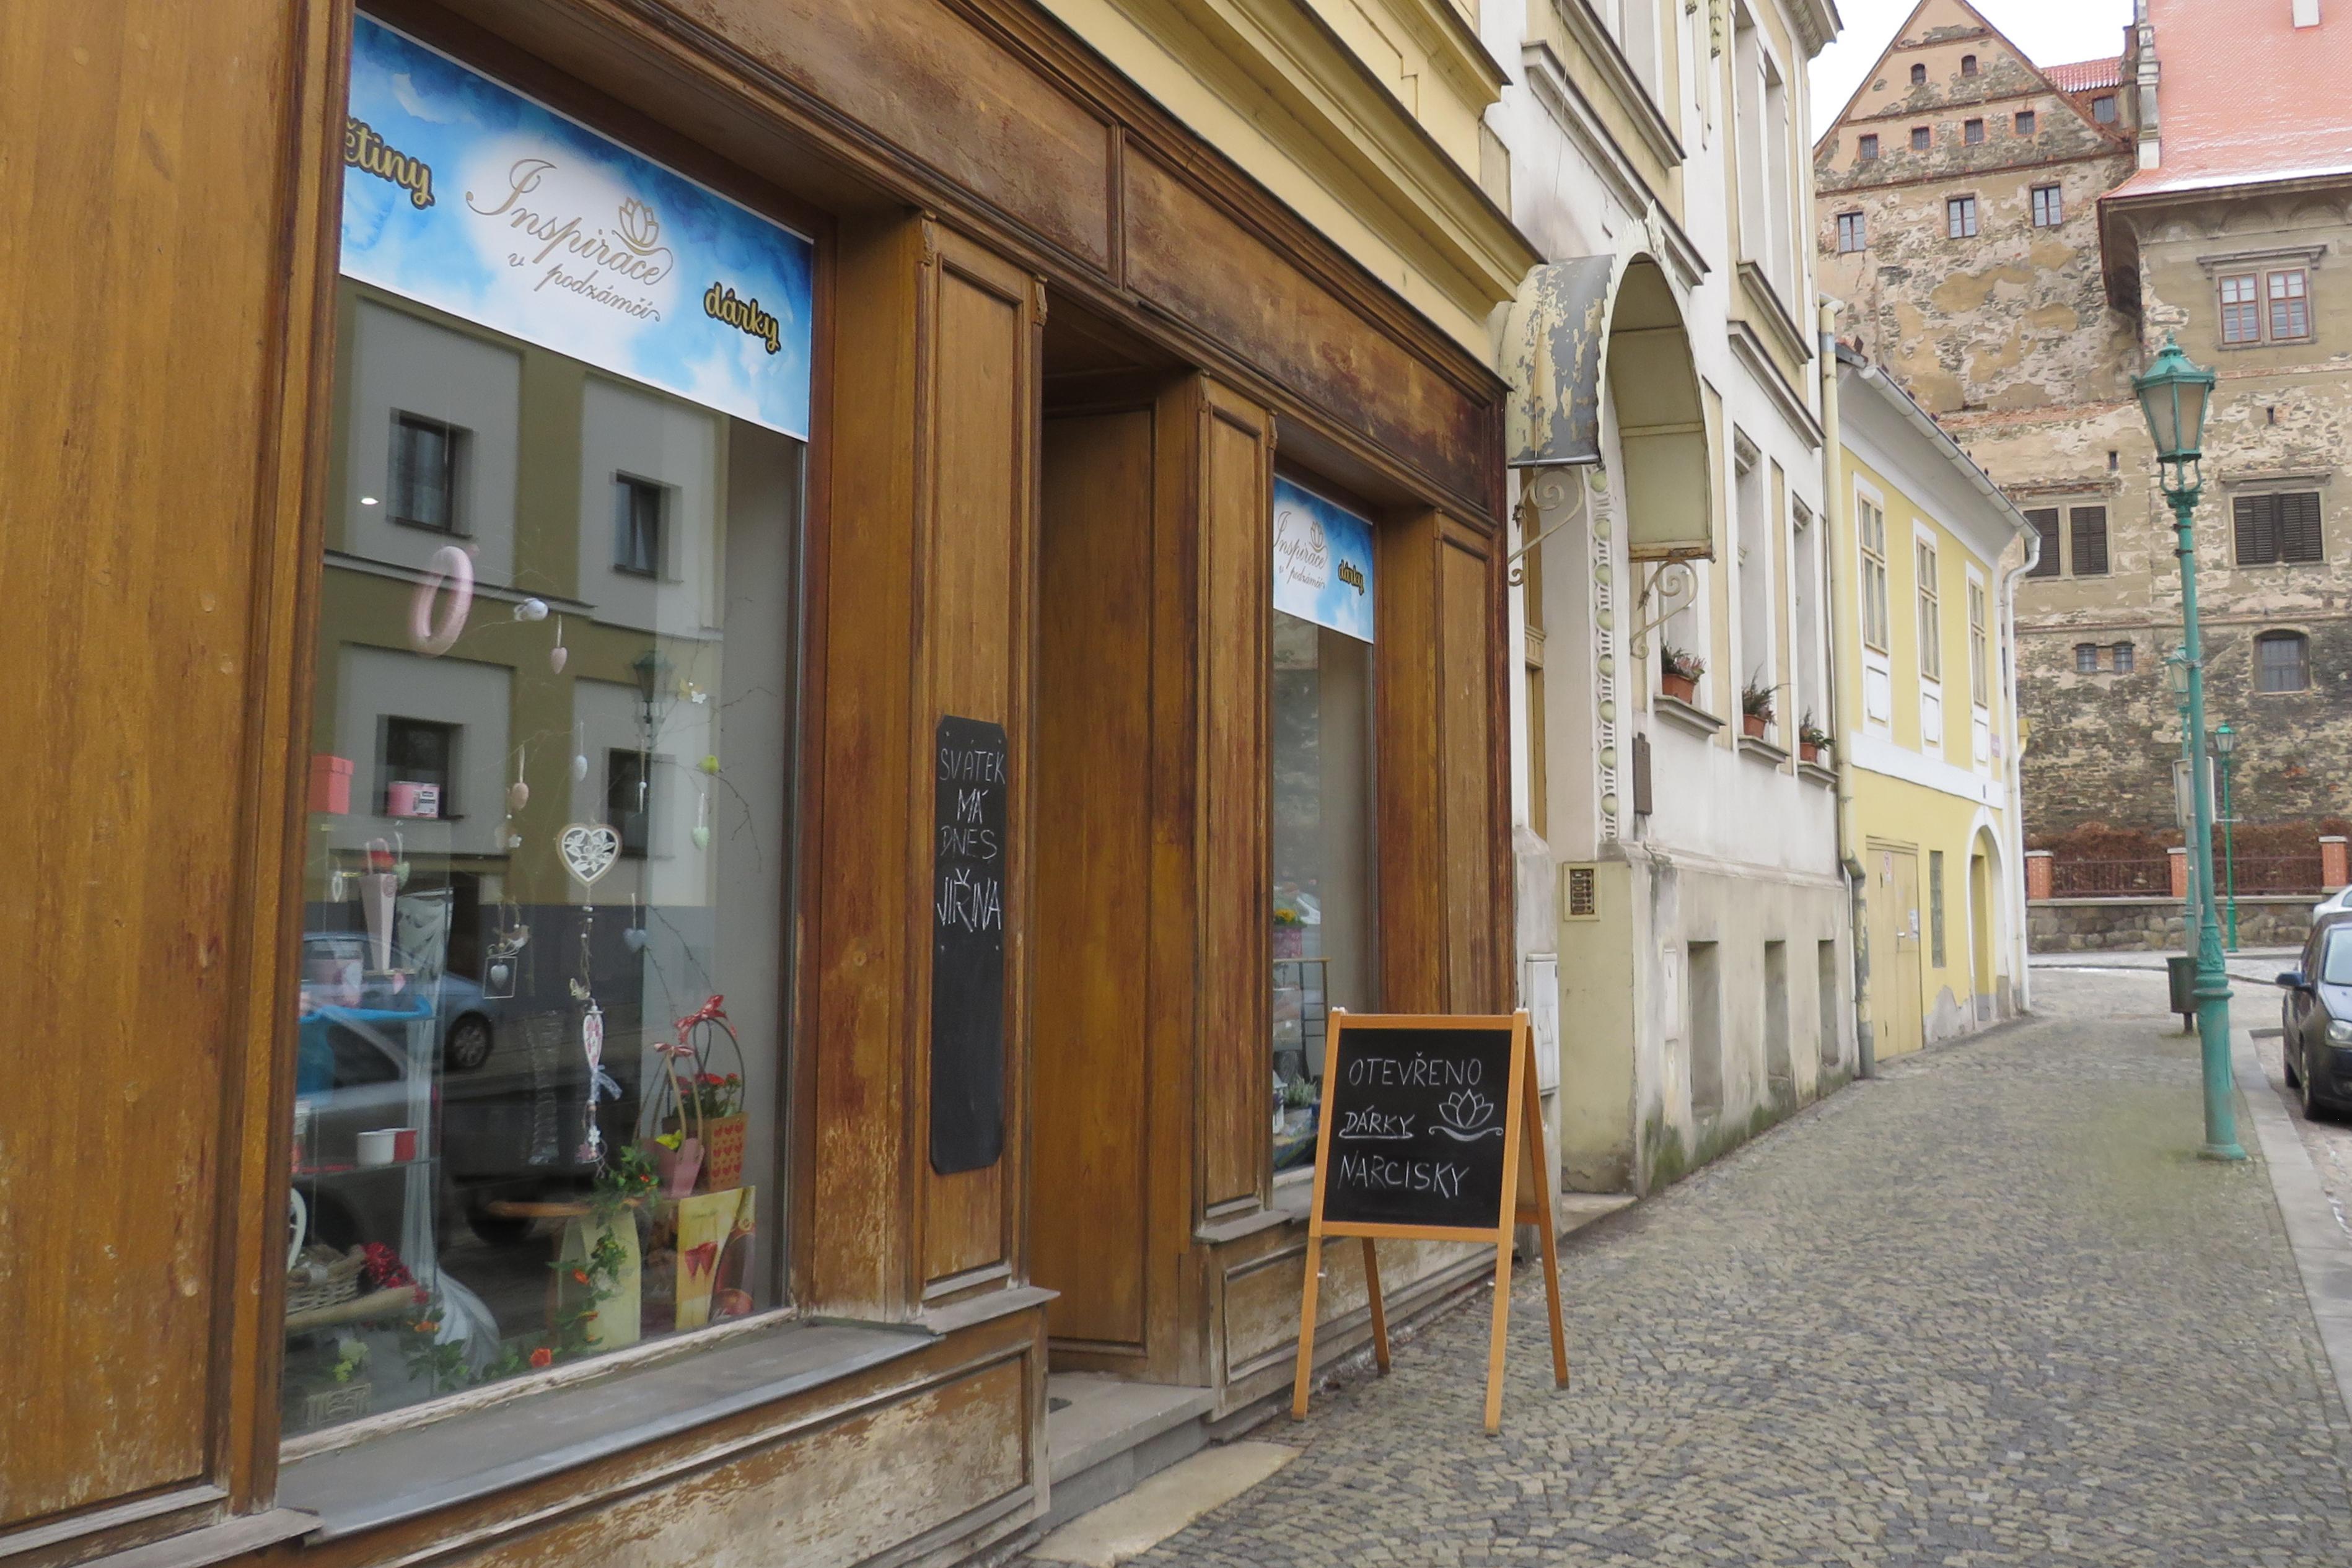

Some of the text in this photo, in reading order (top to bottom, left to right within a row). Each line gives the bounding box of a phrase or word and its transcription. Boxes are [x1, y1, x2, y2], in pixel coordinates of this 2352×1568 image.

[466, 159, 674, 286] Inspirace
[533, 263, 660, 322] podzámčí
[704, 282, 781, 354] dárky
[1273, 511, 1328, 569] Inspirace
[1338, 559, 1364, 596] dárky
[957, 789, 989, 824] MÁ
[940, 825, 998, 859] DNES
[1349, 1051, 1481, 1087] OTEVŘENO
[1345, 1105, 1415, 1134] DÁRKY
[1338, 1150, 1470, 1198] NARCISKY
